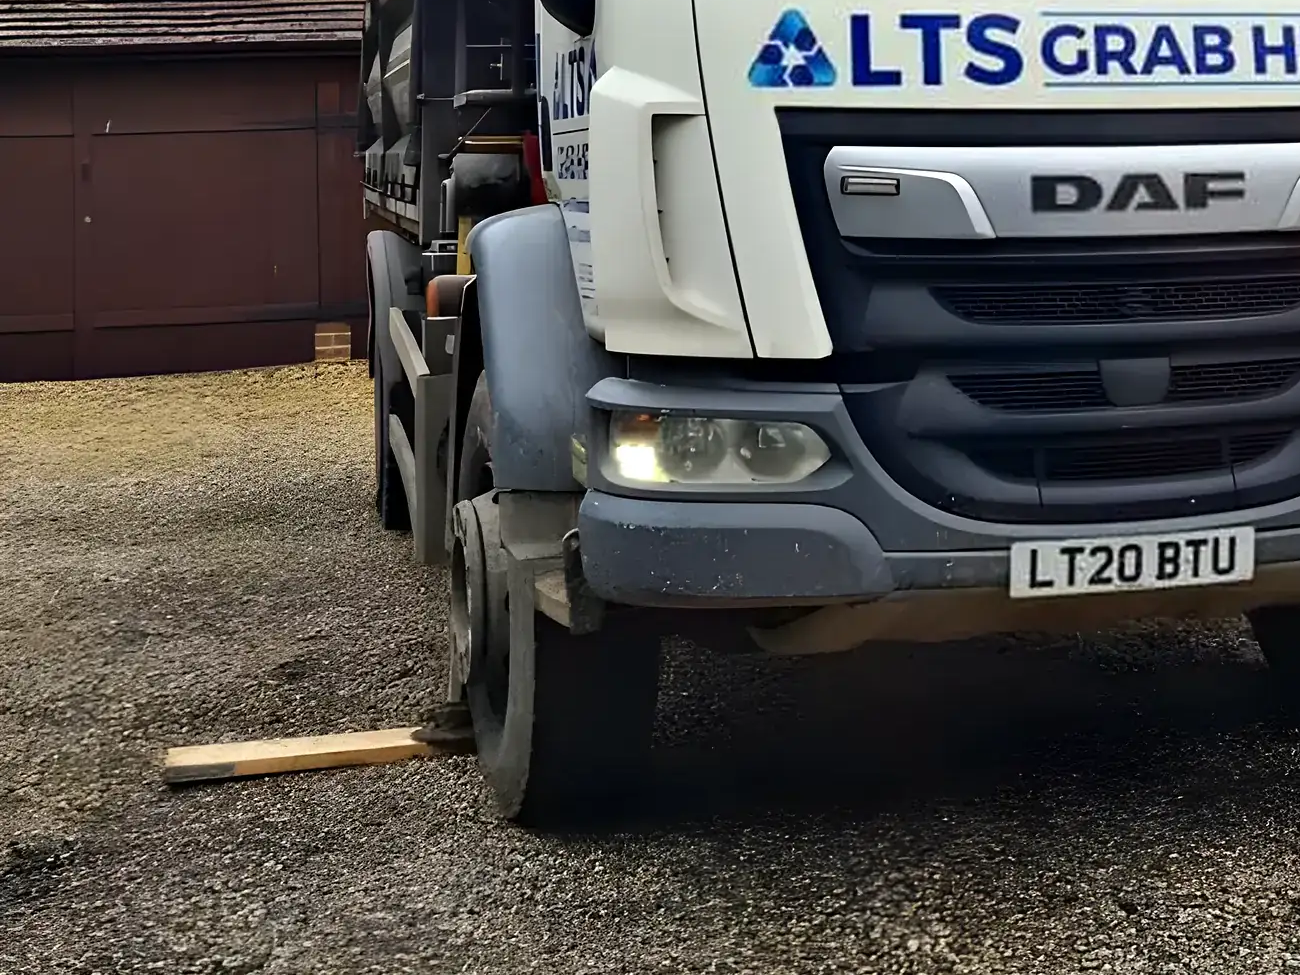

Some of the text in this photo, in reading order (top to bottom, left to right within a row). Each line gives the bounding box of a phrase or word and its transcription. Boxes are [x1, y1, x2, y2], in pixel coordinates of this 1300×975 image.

[850, 13, 1023, 87] LTS
[1040, 24, 1233, 78] GRAB
[1031, 171, 1245, 213] DAF
[1029, 536, 1237, 589] LT20 BTU
